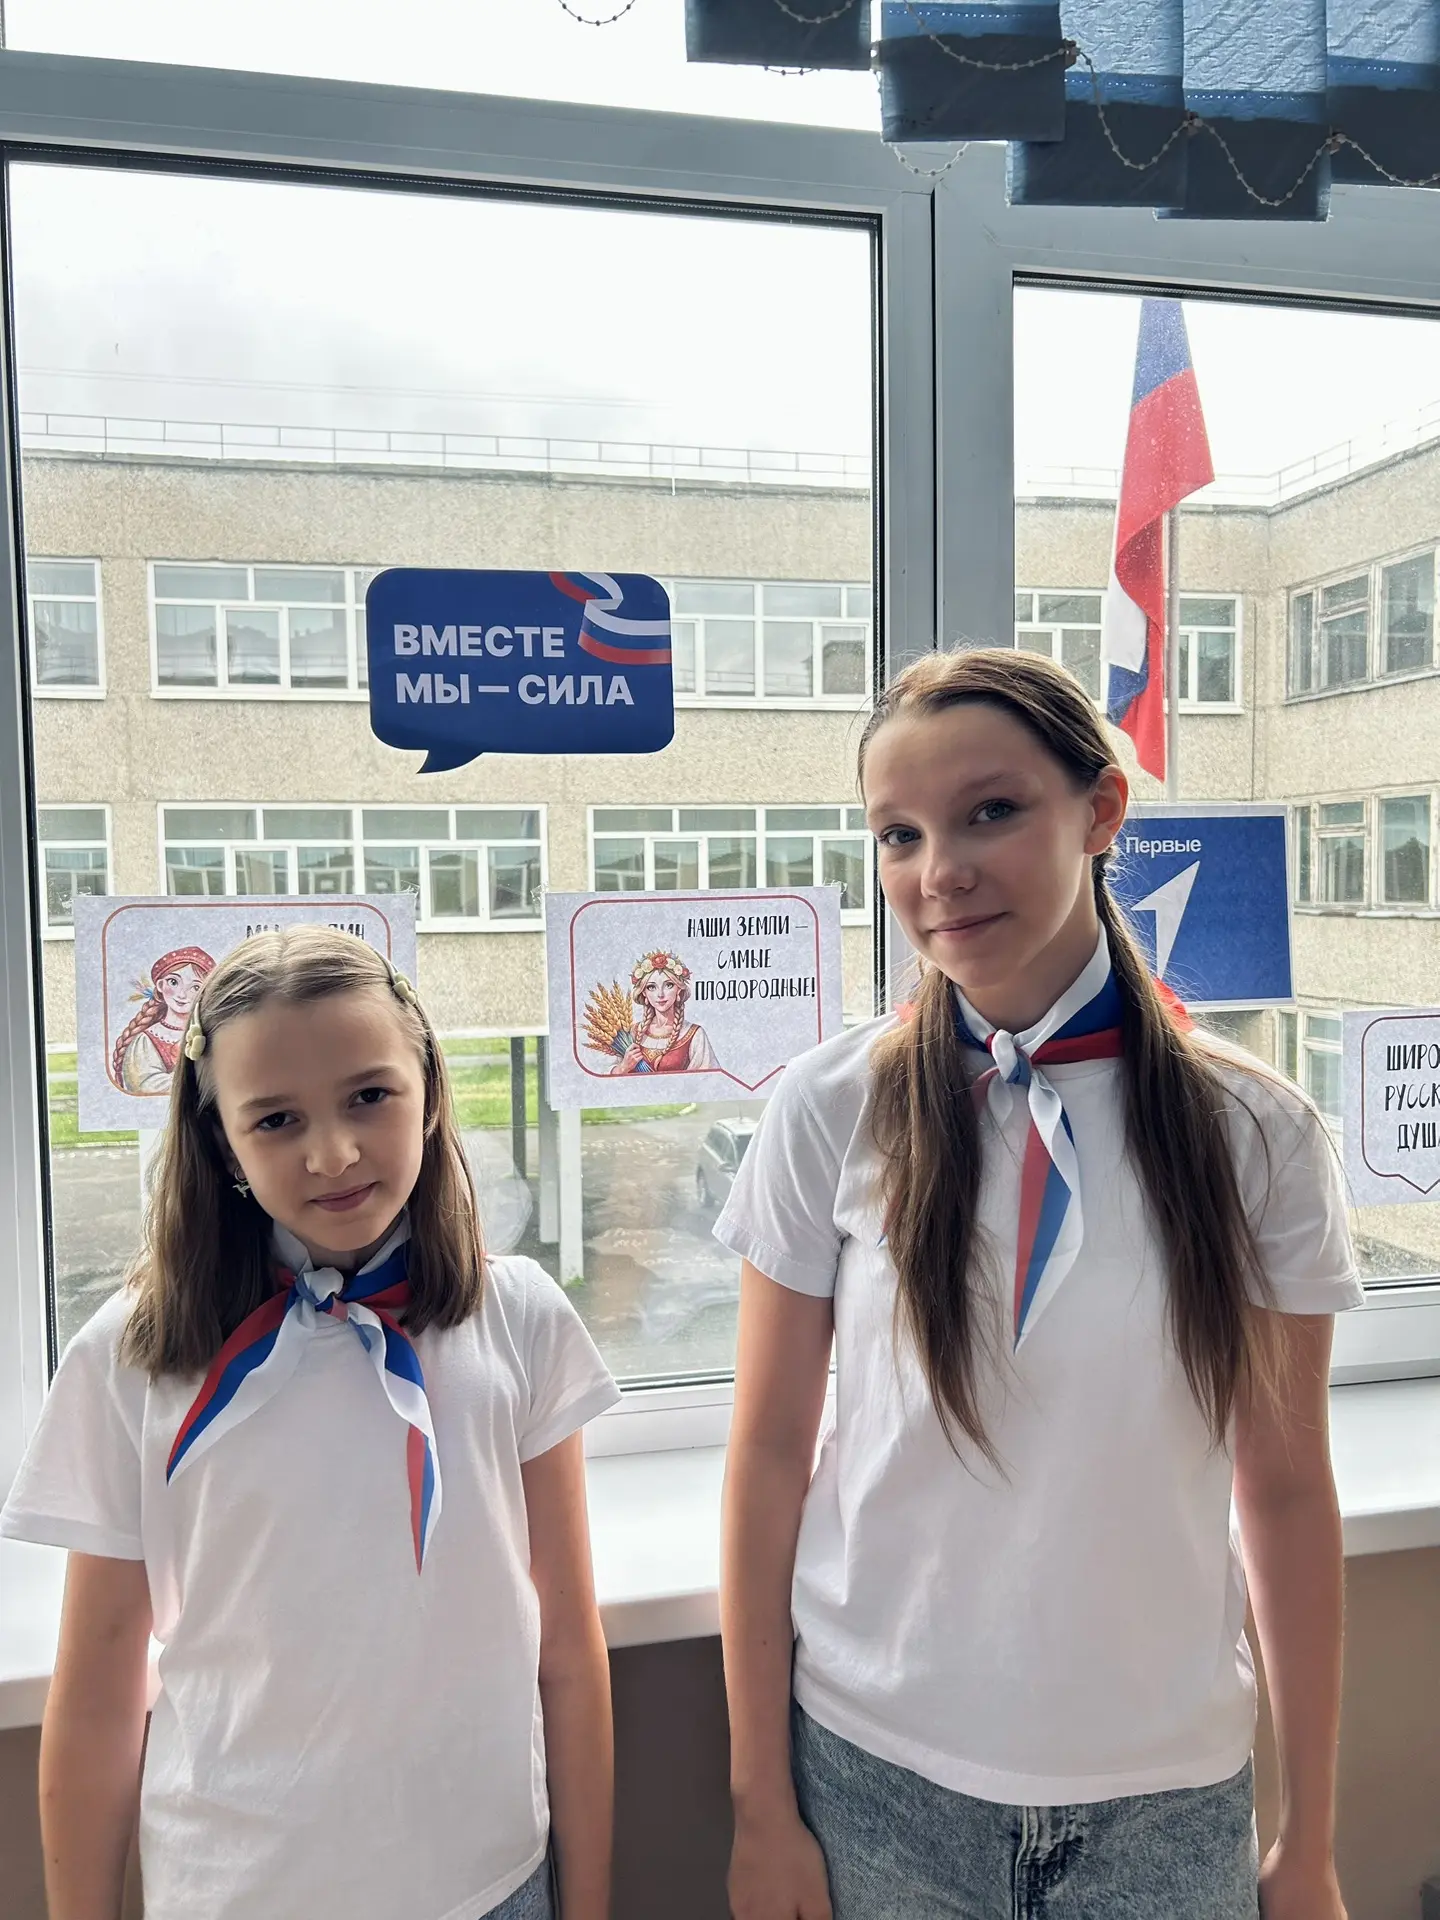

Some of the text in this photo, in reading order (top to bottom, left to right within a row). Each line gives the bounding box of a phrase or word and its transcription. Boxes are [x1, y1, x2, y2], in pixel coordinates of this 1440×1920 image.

[393, 623, 565, 658] ВМЕСТЕ
[395, 672, 471, 704] МЫ
[517, 674, 635, 706] СИЛА
[1125, 836, 1202, 859] Первые
[687, 916, 731, 938] НАШИ
[736, 915, 790, 937] ЗЕМЛИ
[717, 948, 772, 969] САМЫЕ
[694, 976, 816, 1002] ПЛОДОРОДНЫЕ!
[1396, 1121, 1440, 1153] ДУШ
